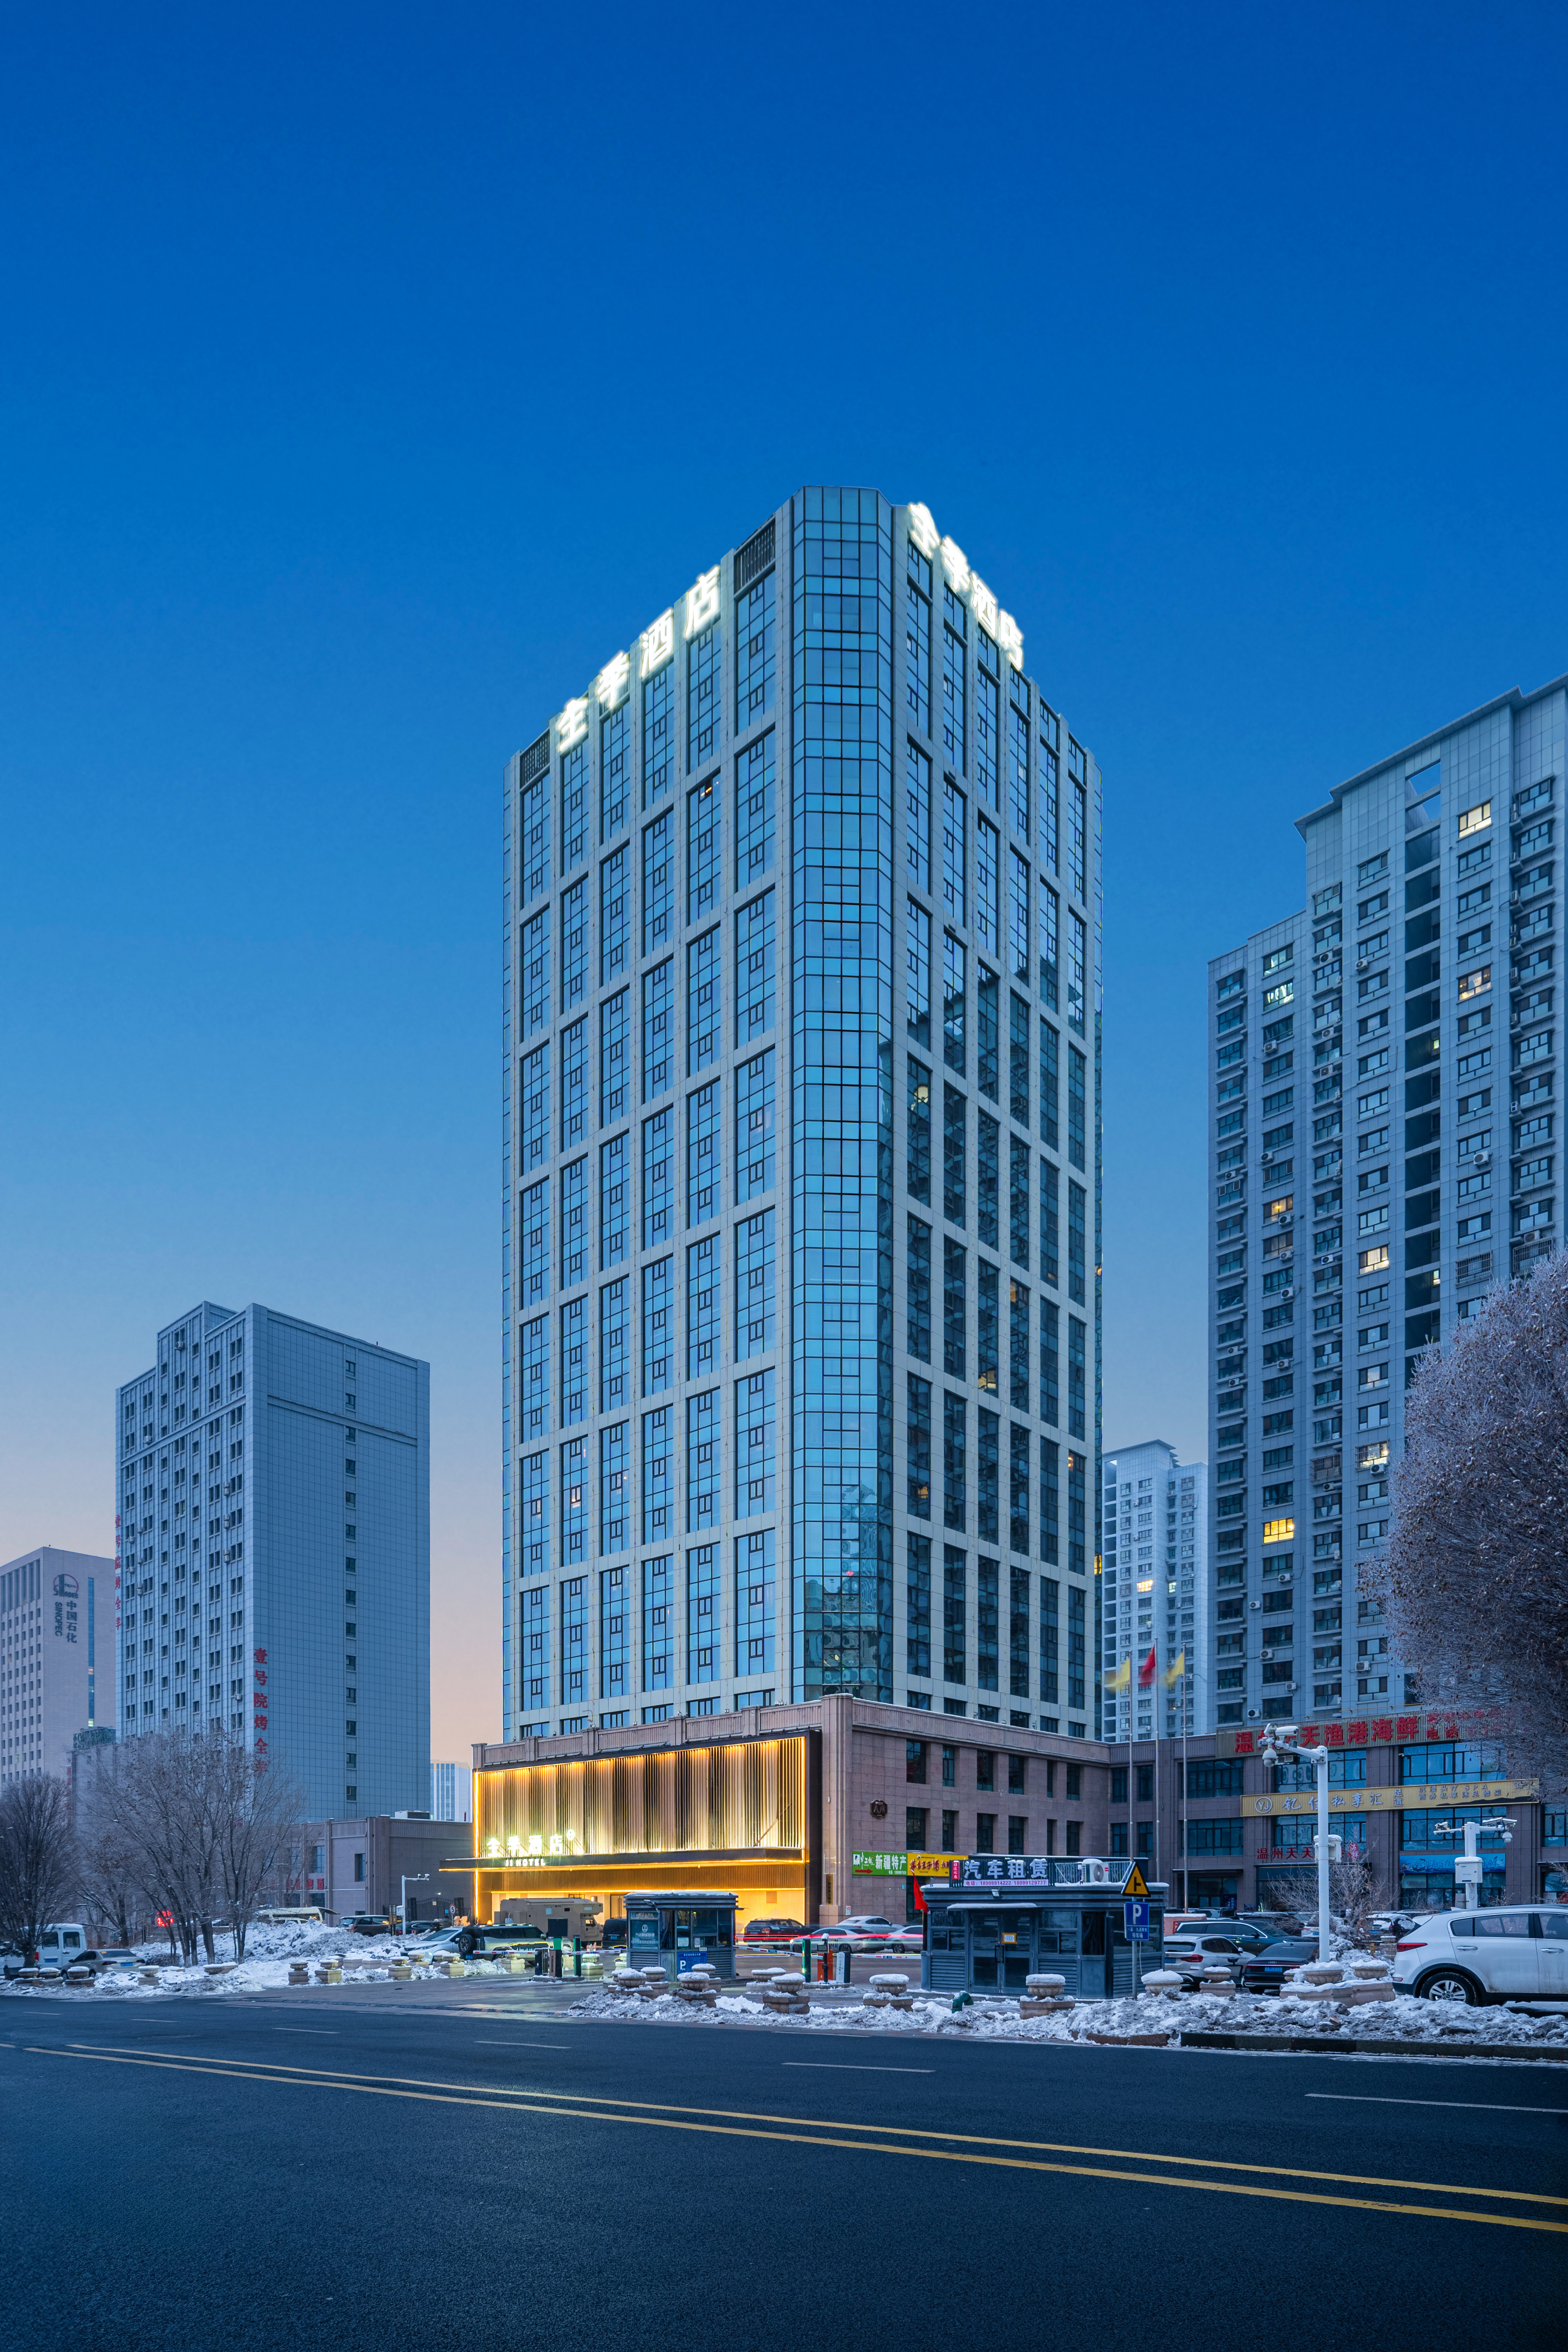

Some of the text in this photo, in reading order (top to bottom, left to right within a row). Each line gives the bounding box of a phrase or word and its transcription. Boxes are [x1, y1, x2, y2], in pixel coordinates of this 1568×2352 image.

[908, 503, 1024, 670] 全季酒店
[557, 564, 721, 753] 全季酒店
[66, 1601, 77, 1643] 中国石化
[254, 1648, 268, 1778] 壹号院烤全羊
[1235, 1715, 1419, 1753] 温天渔港海鲜
[1394, 1789, 1403, 1806] 足道
[486, 1833, 563, 1858] 全季酒店
[516, 1858, 545, 1866] HOTEL
[875, 1854, 906, 1870] 新疆特产
[909, 1858, 939, 1871] 茅台王子酒
[964, 1858, 1048, 1879] 汽车租赁
[1406, 1859, 1497, 1869] 不到海边鲜
[1133, 1904, 1142, 1924] P
[680, 1960, 686, 1970] P
